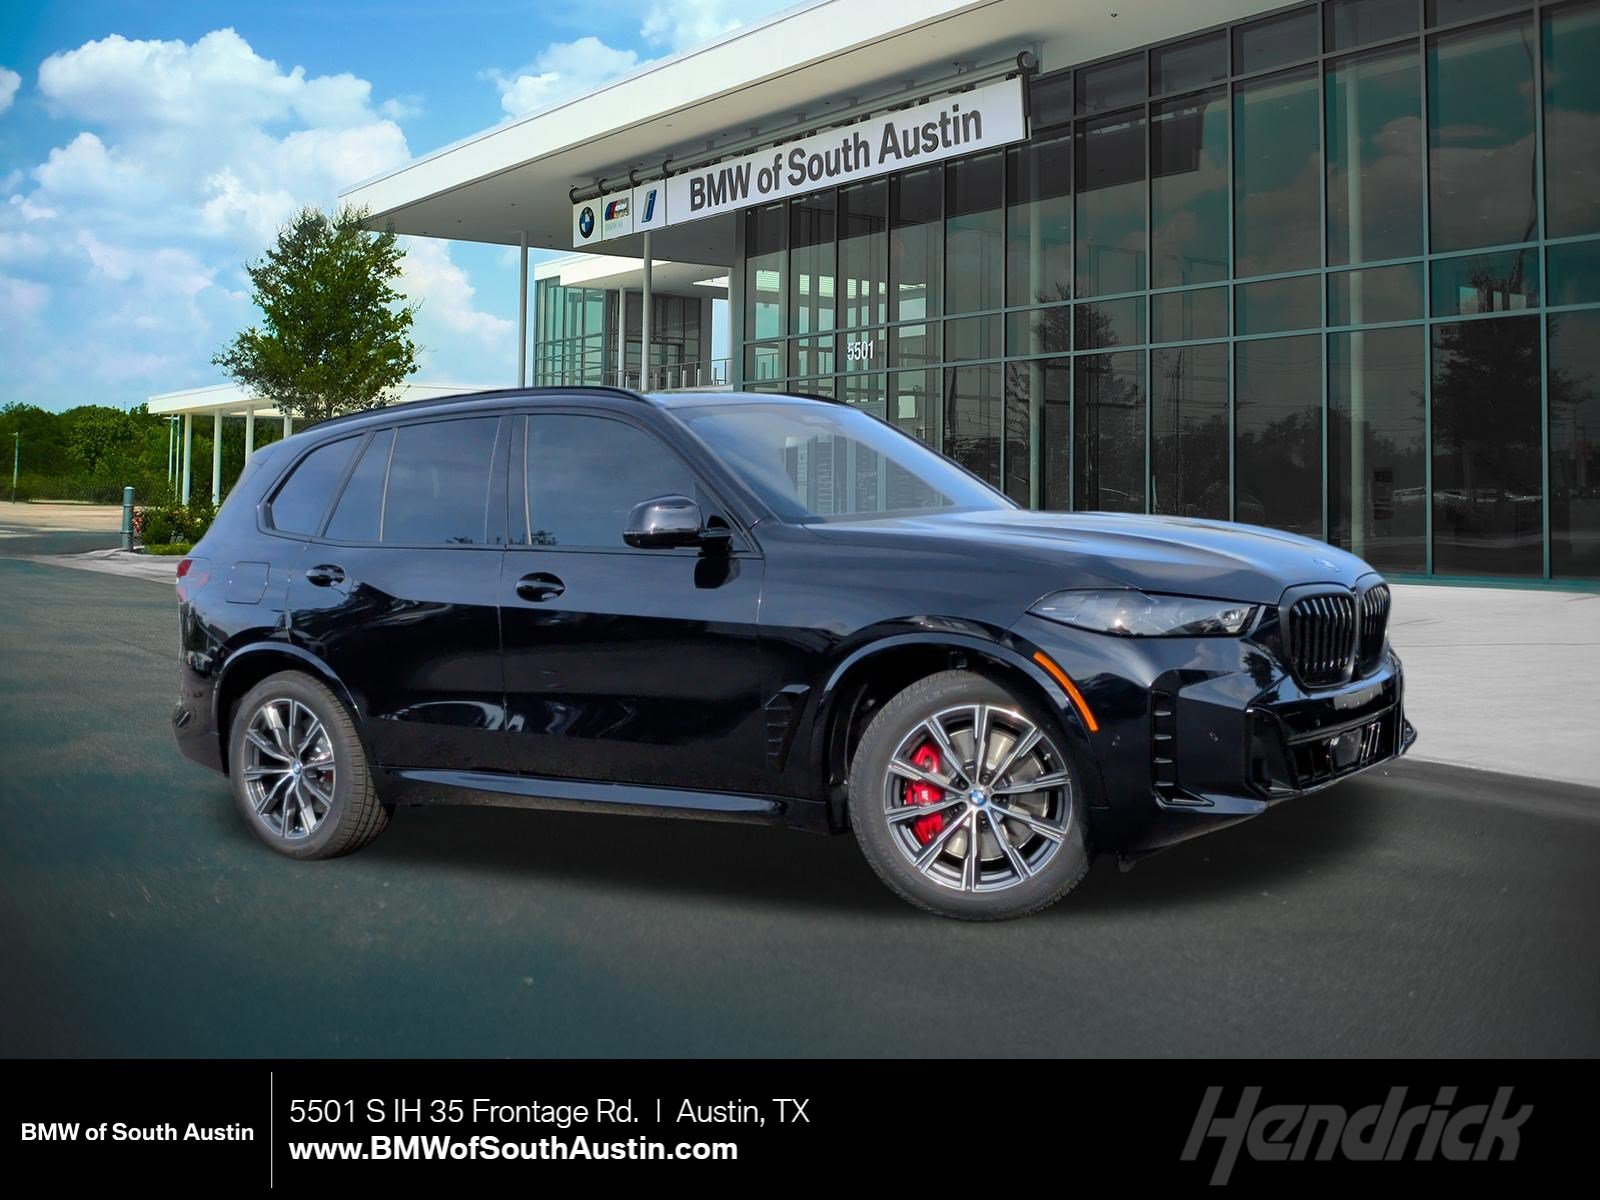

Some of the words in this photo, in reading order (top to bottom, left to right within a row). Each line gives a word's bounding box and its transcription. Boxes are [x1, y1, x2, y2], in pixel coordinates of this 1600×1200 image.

[690, 162, 751, 212] BMW
[757, 153, 783, 194] of
[787, 131, 870, 186] South
[878, 103, 982, 165] Austin
[847, 340, 873, 360] 5501
